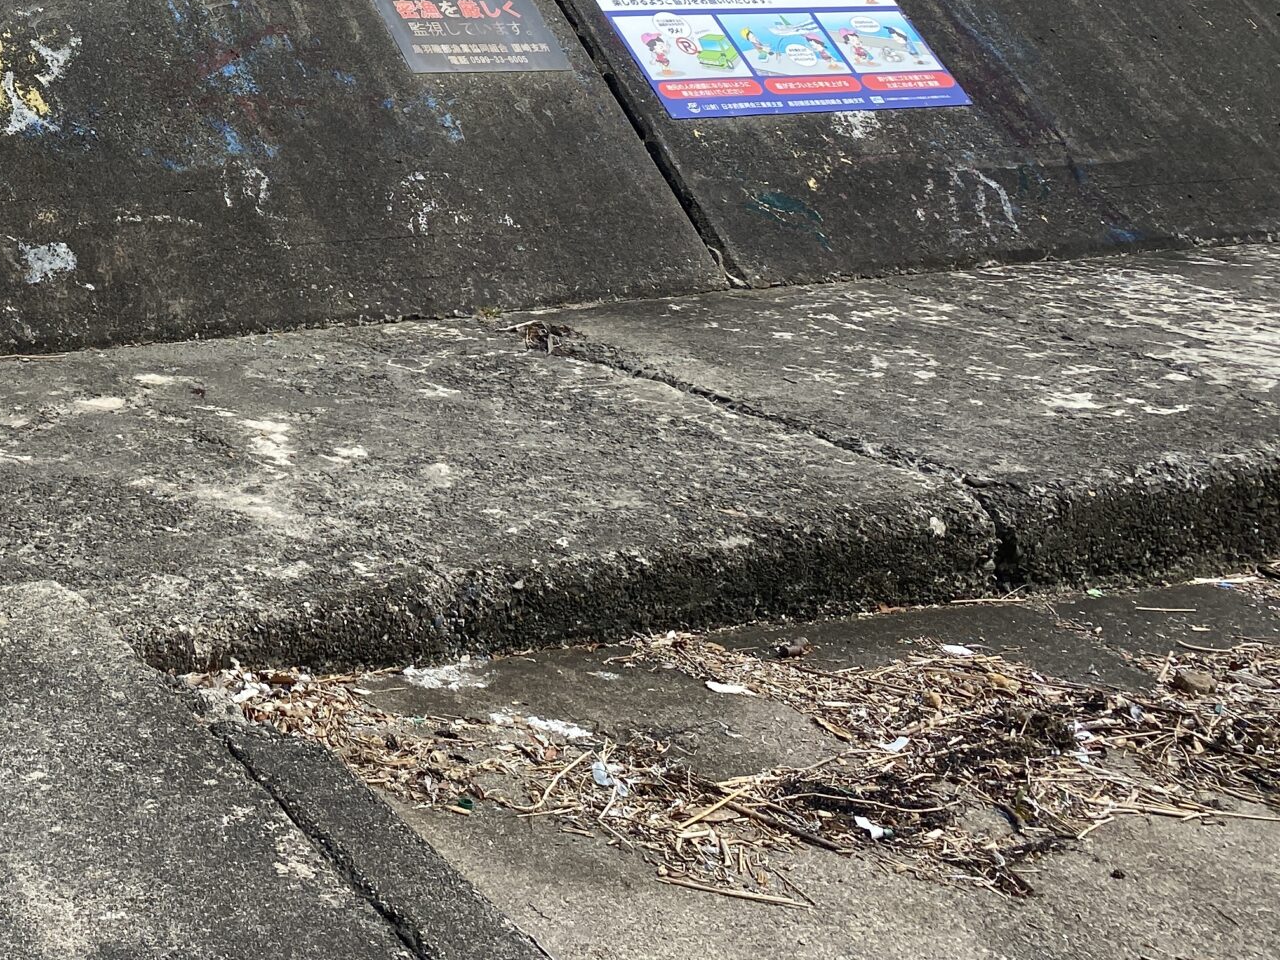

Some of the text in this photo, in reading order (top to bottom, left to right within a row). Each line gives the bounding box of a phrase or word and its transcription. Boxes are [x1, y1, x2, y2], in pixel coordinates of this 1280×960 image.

[392, 0, 523, 20] 密漁を厳しく
[407, 21, 533, 37] 監視しています。
[448, 55, 469, 65] 電話
